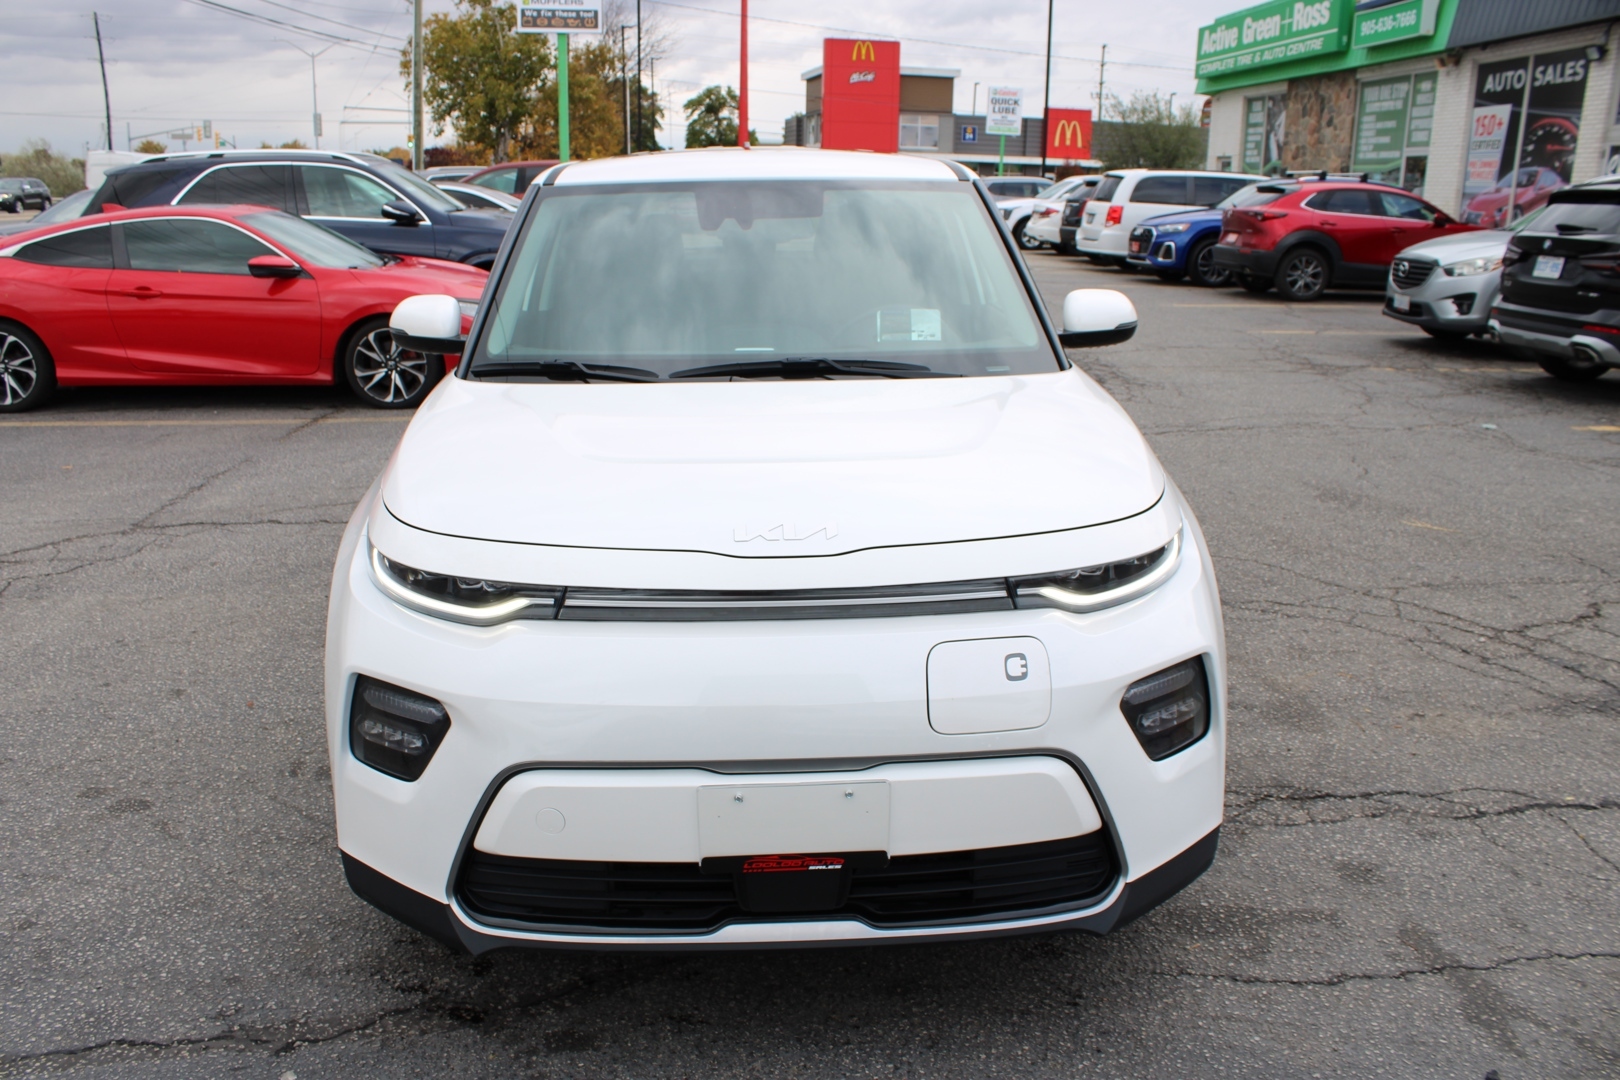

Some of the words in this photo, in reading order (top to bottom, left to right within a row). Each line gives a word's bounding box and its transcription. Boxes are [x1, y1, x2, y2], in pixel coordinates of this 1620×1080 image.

[524, 9, 538, 17] We
[540, 9, 552, 17] fix
[555, 10, 577, 18] these
[1201, 24, 1238, 55] Active
[1199, 57, 1235, 74] COMPLETE
[1237, 54, 1253, 67] TIRE
[1254, 51, 1261, 63] &
[1262, 46, 1286, 61] AUTO
[1287, 37, 1324, 56] CENTRE
[1482, 68, 1527, 93] AUTO
[1533, 59, 1587, 87] SALES
[991, 97, 1021, 106] QUICK
[992, 106, 1018, 115] LUBE
[1474, 113, 1504, 137] 150+
[1471, 139, 1502, 151] CERTIFIED
[804, 858, 845, 866] AUTO
